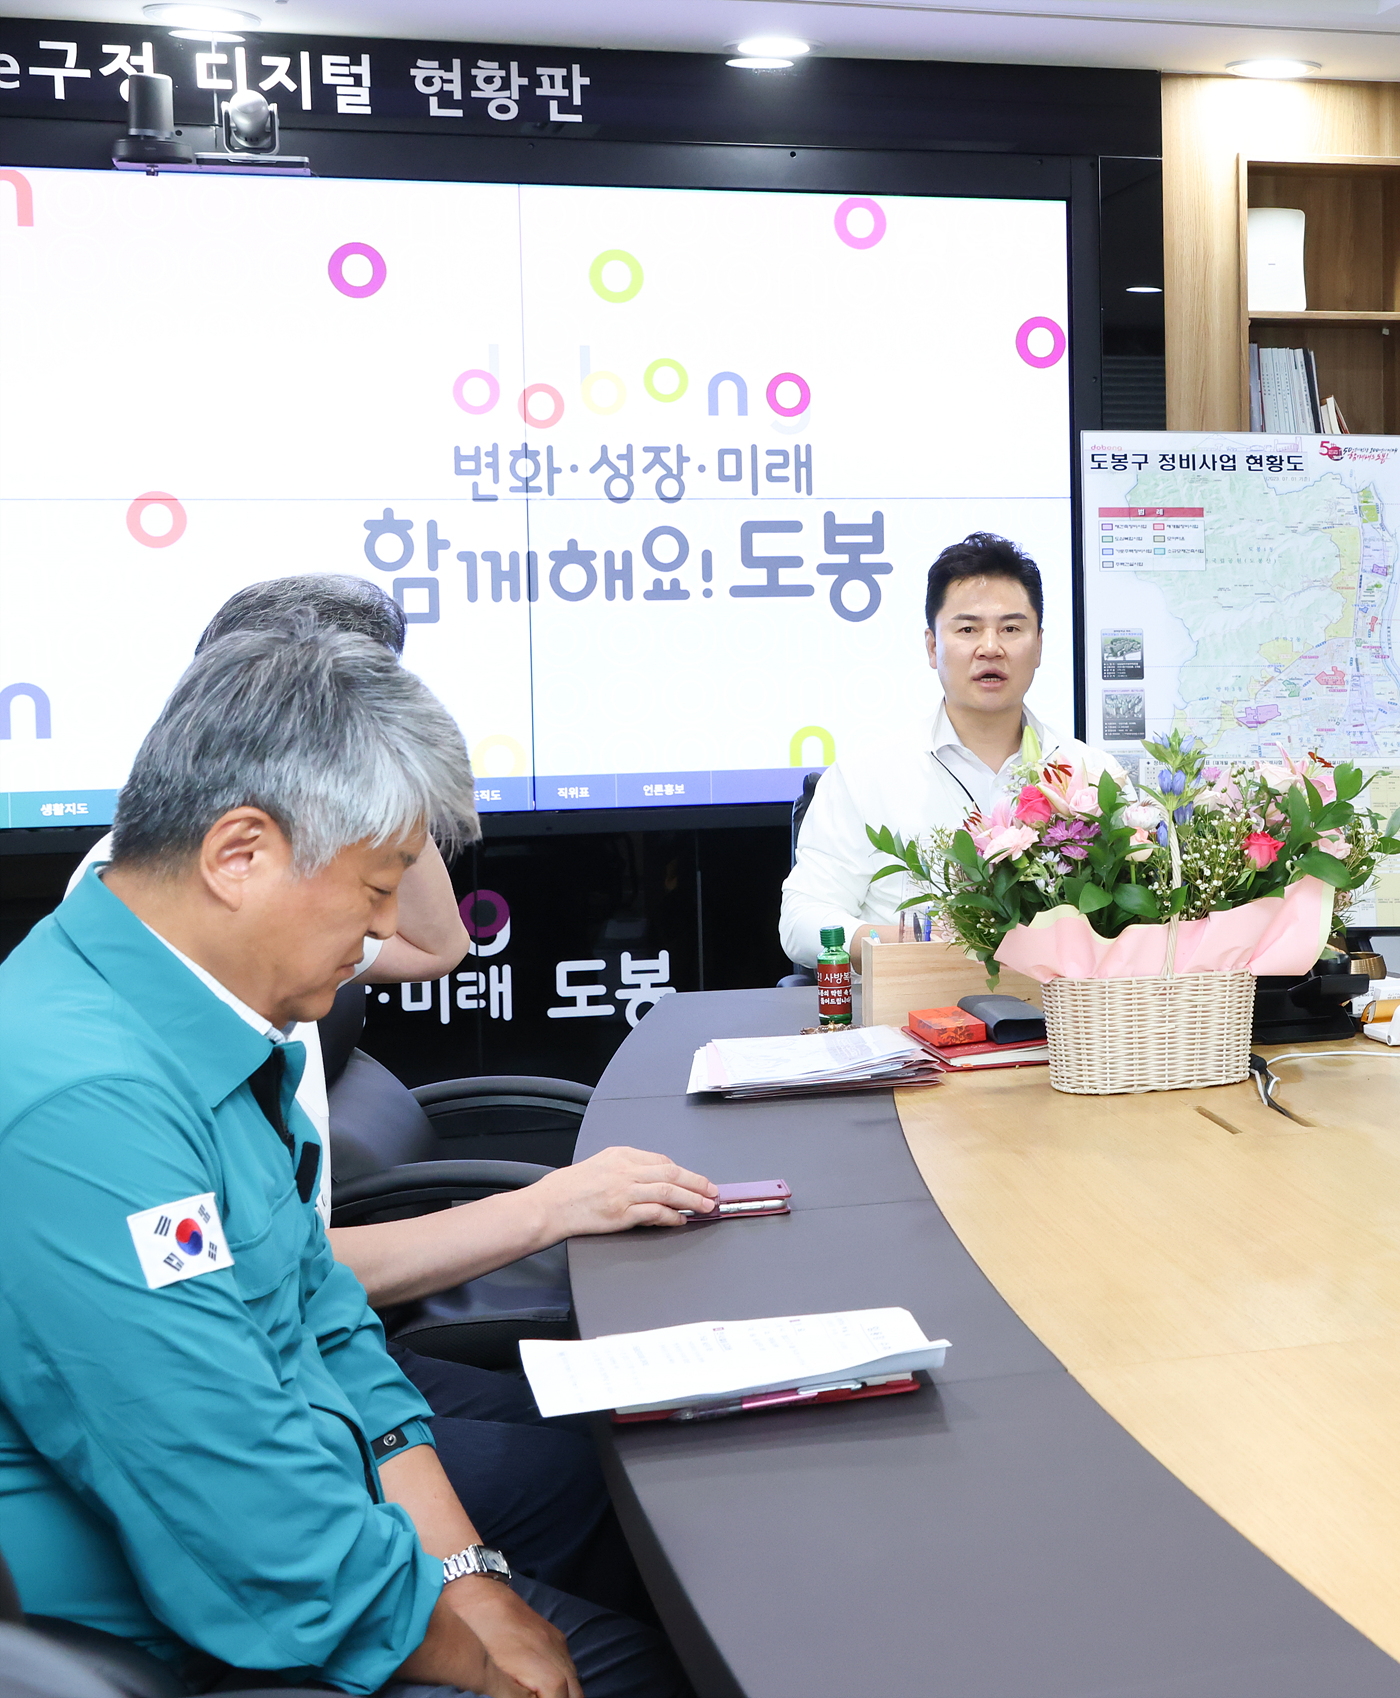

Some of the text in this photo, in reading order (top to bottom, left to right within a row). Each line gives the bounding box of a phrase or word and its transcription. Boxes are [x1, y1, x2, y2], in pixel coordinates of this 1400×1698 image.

[194, 47, 373, 115] 디지털
[409, 57, 591, 123] 현황판
[452, 442, 814, 504] 변화·성장·미래
[1089, 452, 1305, 473] 도봉구 정비사업 현황도
[362, 507, 894, 624] 함께해요! 도봉
[40, 802, 89, 817] 생활지도
[557, 786, 591, 800] 직위표
[643, 783, 686, 797] 언론홍보
[546, 949, 677, 1029] 도봉
